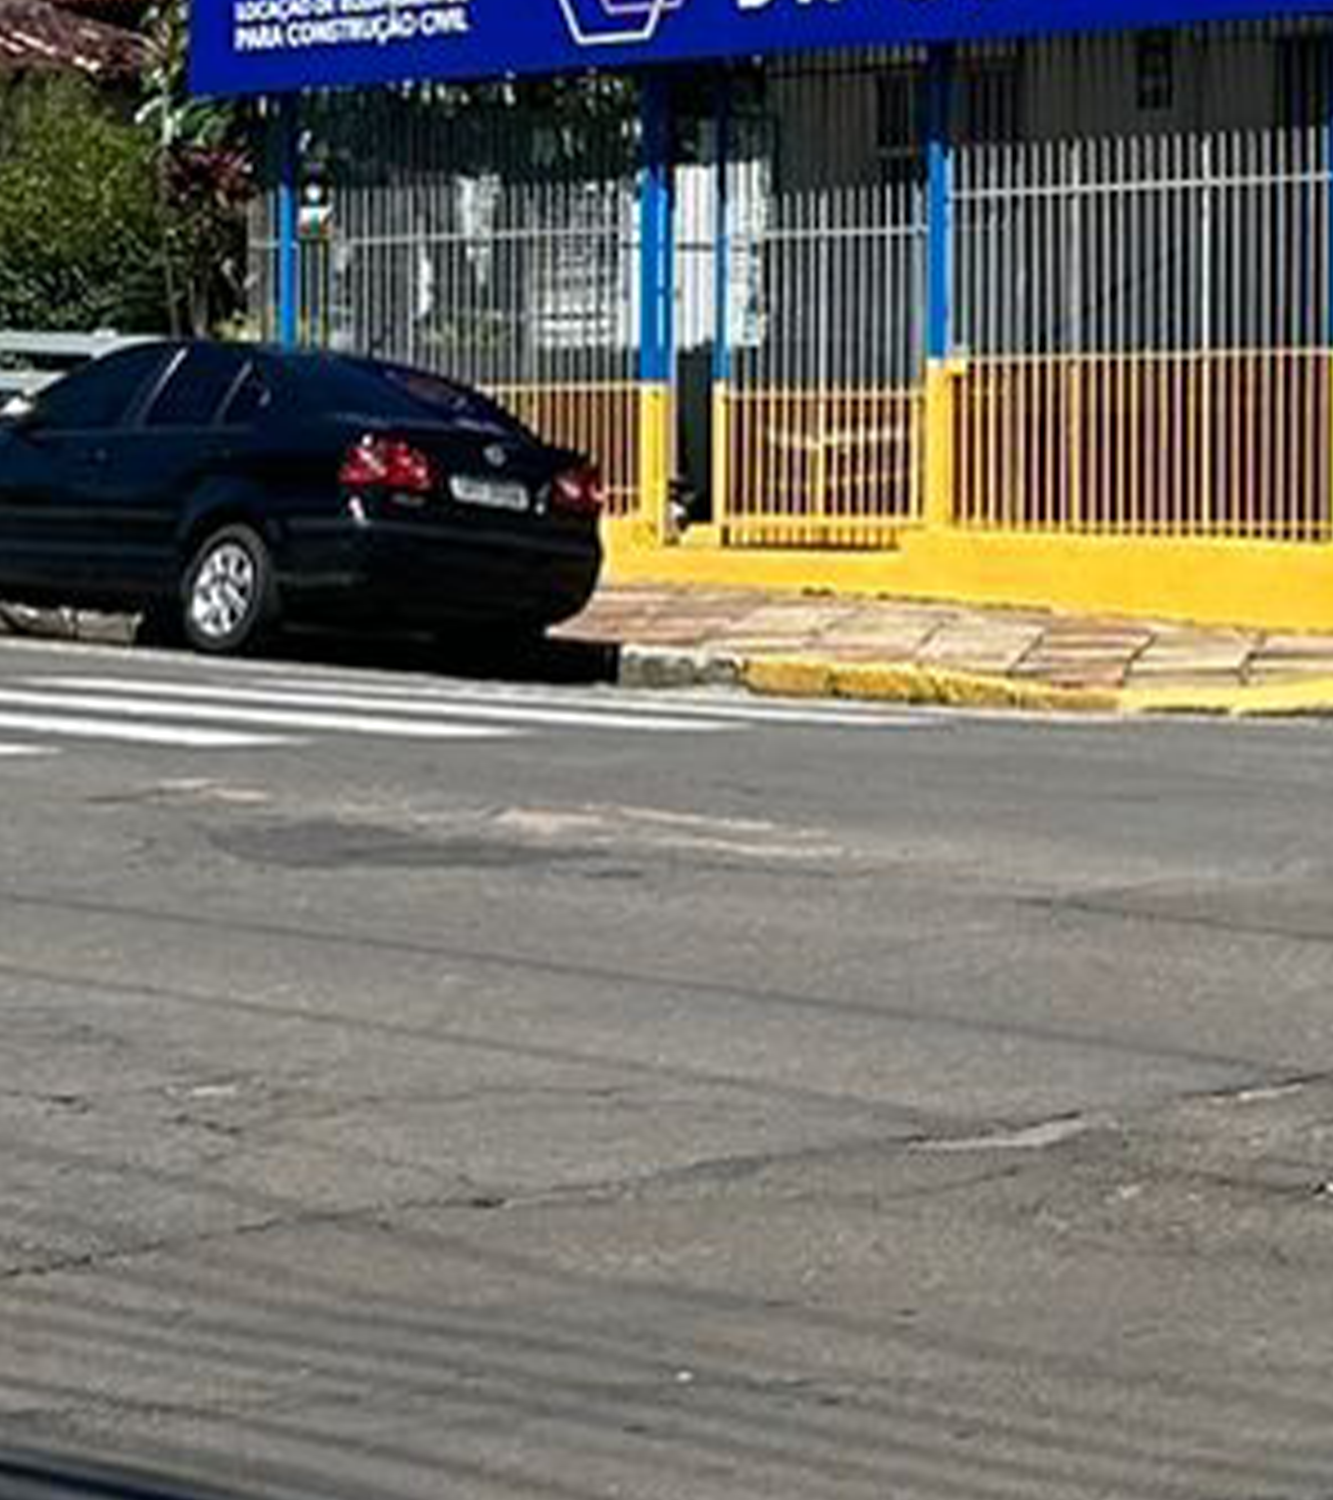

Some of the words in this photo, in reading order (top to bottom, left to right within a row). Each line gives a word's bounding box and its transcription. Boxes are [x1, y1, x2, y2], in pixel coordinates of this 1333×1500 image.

[234, 25, 284, 49] PARA
[287, 11, 418, 46] CONSTRUÇÃO
[420, 7, 469, 36] CIVIL
